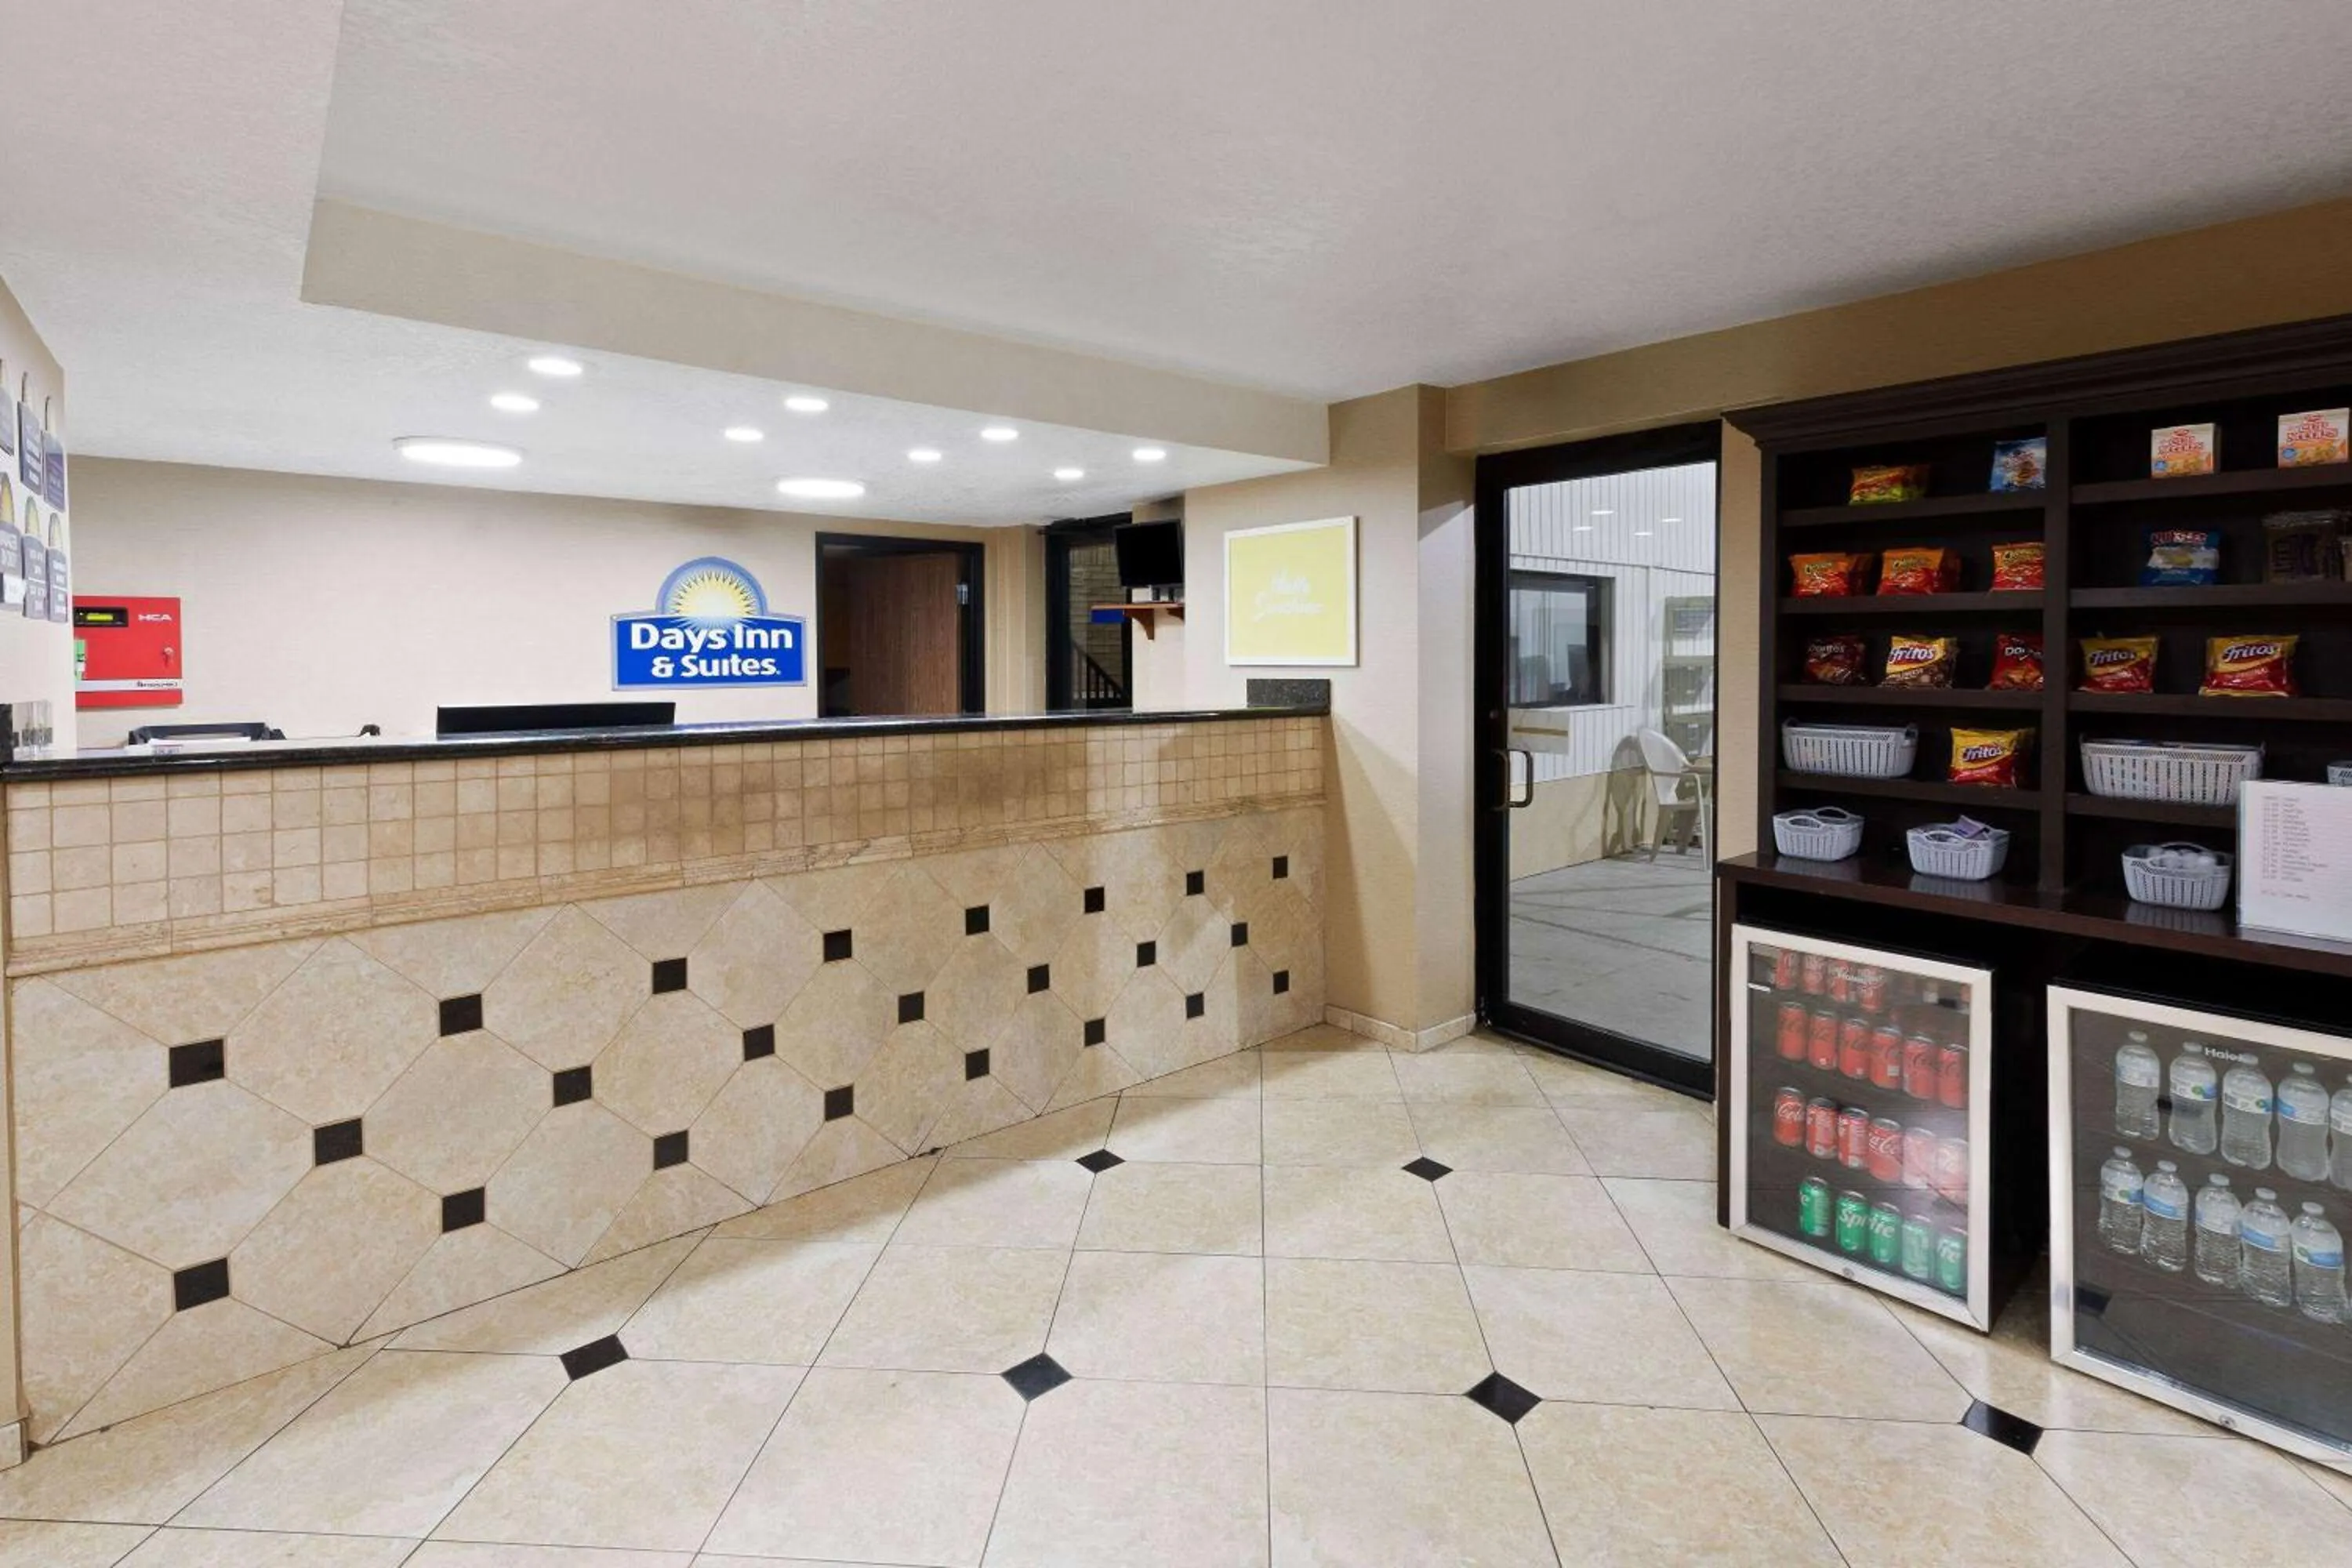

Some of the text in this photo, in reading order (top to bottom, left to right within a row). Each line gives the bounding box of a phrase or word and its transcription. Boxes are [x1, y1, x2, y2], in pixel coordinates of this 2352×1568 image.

[631, 622, 793, 653] Days Inn
[1887, 645, 1936, 665] Fritos
[2222, 644, 2277, 663] Fritos
[652, 656, 675, 678] &
[1962, 744, 2003, 762] Fritos
